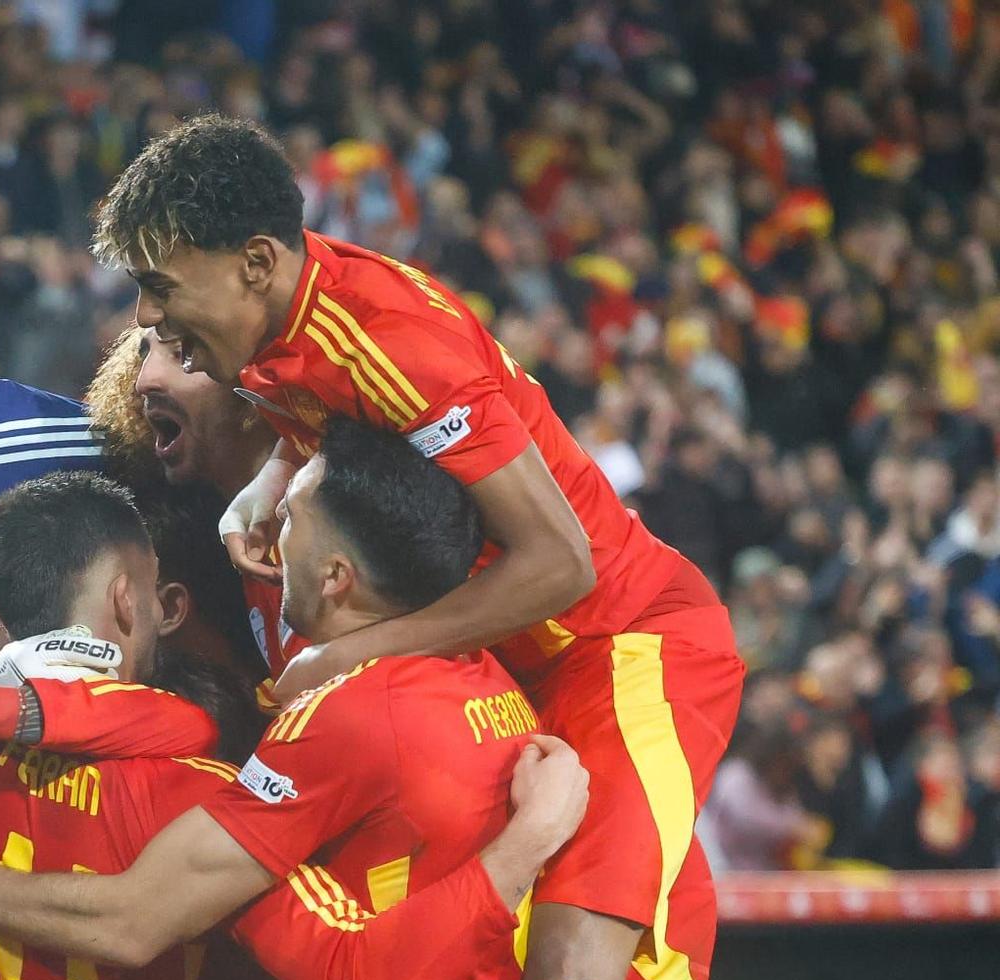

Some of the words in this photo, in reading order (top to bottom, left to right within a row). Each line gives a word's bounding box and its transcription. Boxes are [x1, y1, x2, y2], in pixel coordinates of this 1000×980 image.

[440, 417, 462, 437] 10
[35, 640, 116, 661] reusch
[464, 690, 537, 744] MERINO
[262, 776, 283, 797] 10
